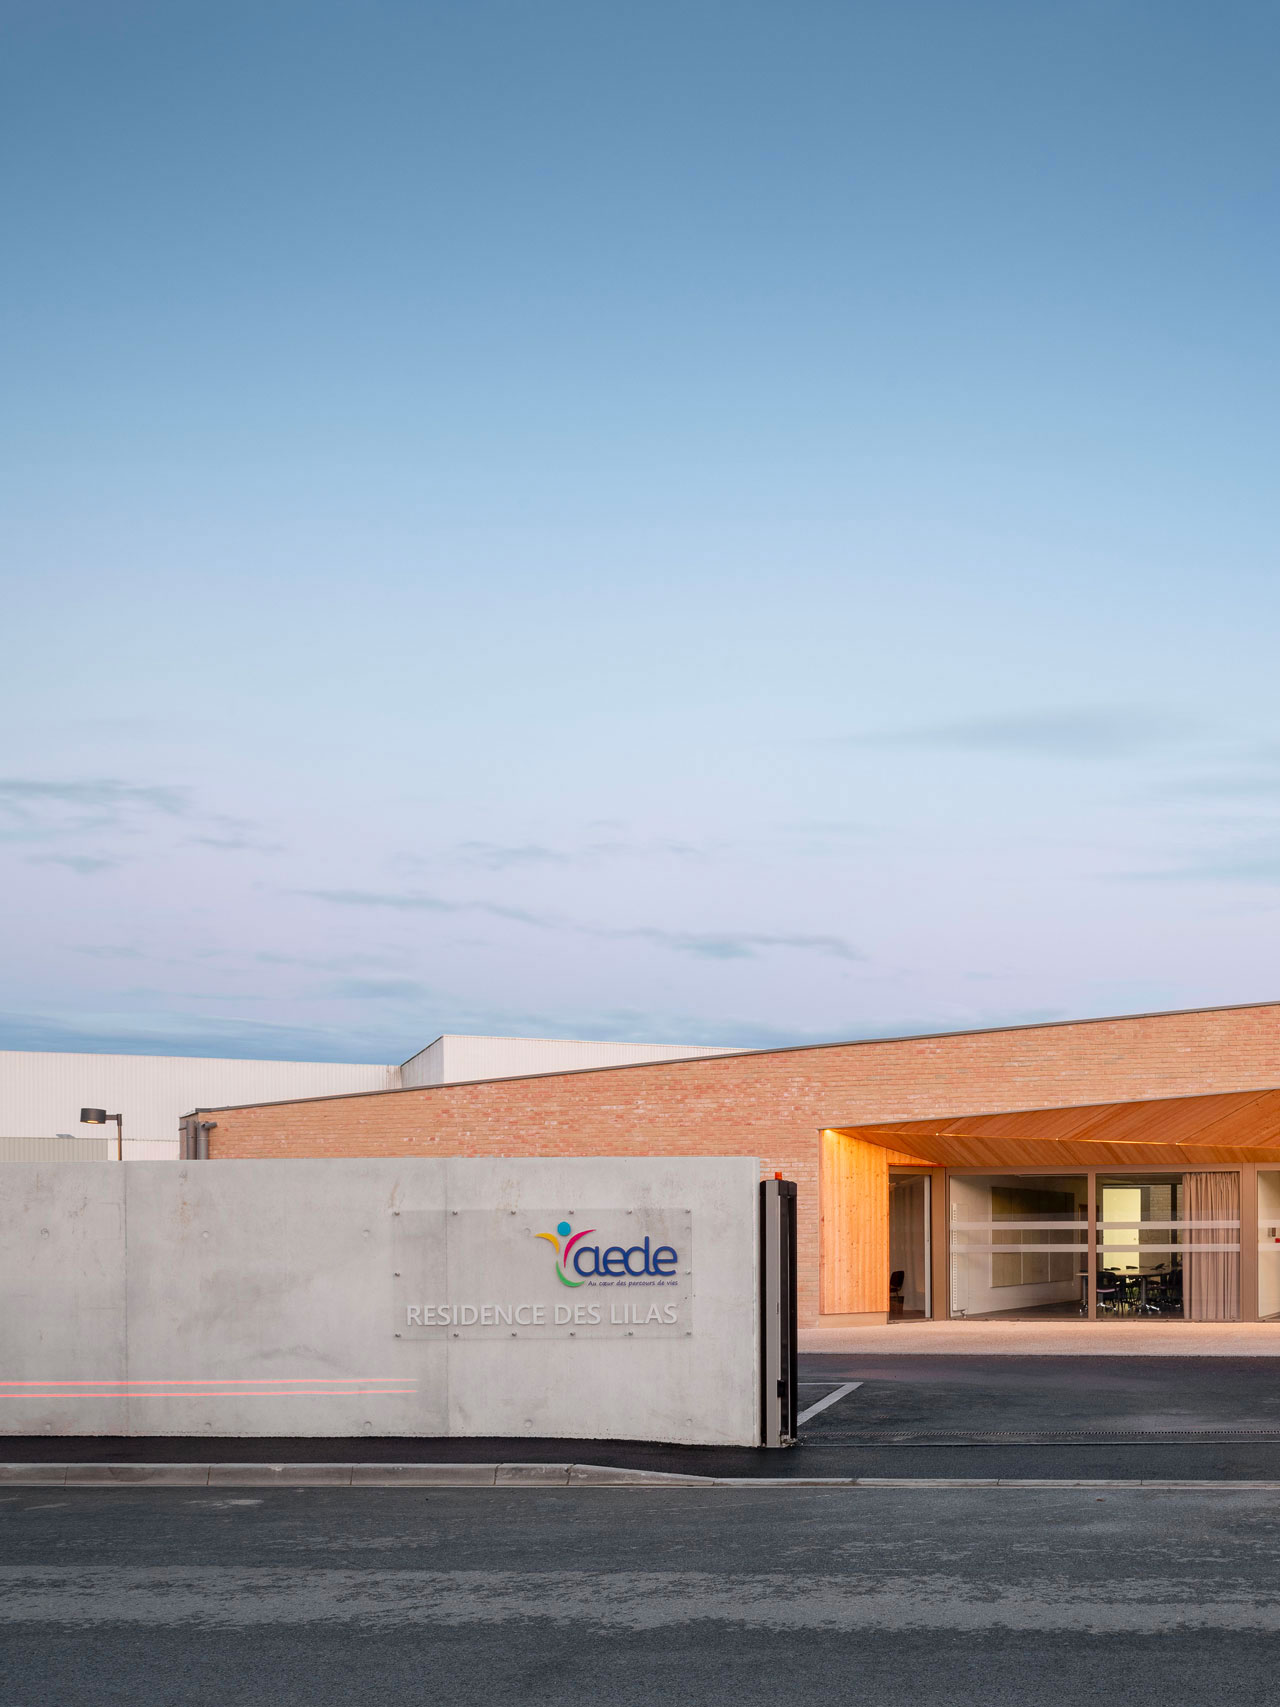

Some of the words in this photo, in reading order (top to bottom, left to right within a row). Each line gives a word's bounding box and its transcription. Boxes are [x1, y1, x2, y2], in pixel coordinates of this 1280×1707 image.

[573, 1235, 678, 1277] aede
[406, 1304, 546, 1326] RESIDENCE
[554, 1304, 601, 1325] DES
[610, 1303, 678, 1325] LILAS
